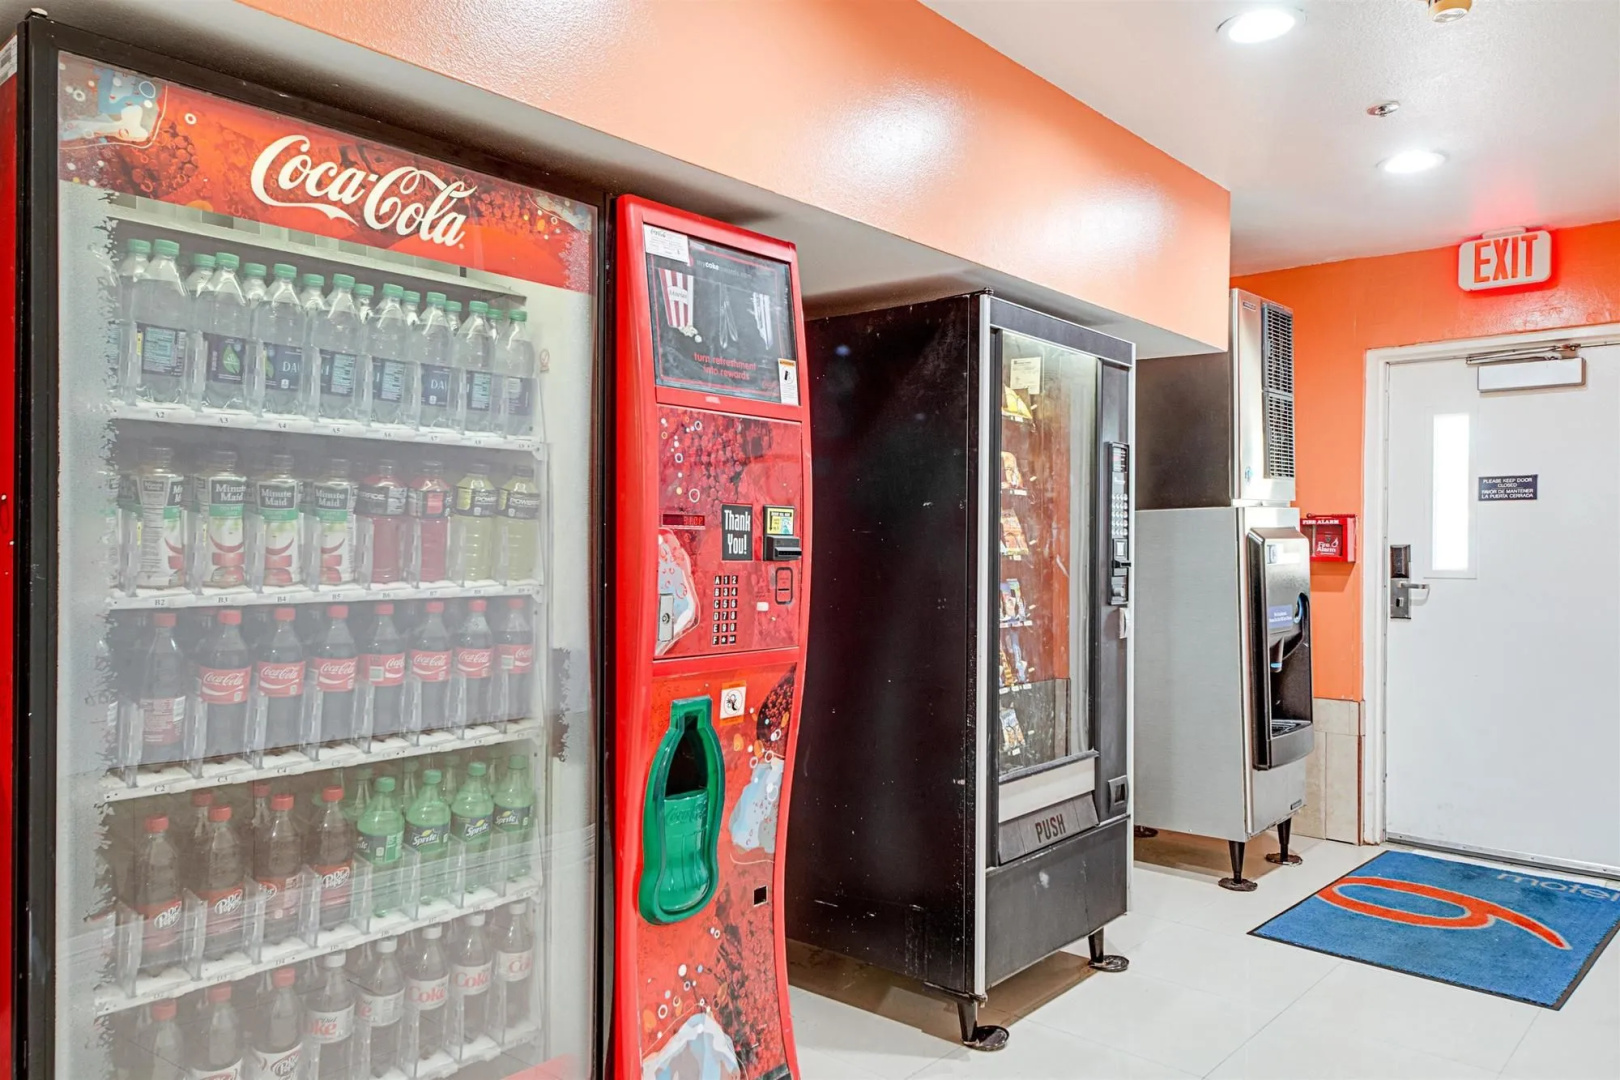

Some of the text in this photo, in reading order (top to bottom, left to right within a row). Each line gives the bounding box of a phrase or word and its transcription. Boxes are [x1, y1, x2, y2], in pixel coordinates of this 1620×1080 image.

[250, 134, 477, 247] Coca-Cola
[1474, 233, 1538, 283] EXIT
[693, 352, 710, 364] turn
[720, 367, 750, 380] rewards
[220, 491, 244, 502] Maid
[261, 487, 292, 498] Minute
[265, 497, 288, 506] Maid
[319, 498, 340, 507] Maid
[724, 509, 751, 532] Thank
[727, 533, 747, 555] You!
[1318, 541, 1330, 549] Fire
[714, 575, 720, 585] A
[732, 575, 737, 584] 2
[714, 588, 720, 597] B
[731, 587, 737, 596] 4
[714, 599, 719, 609] C
[731, 599, 736, 608] 6
[713, 612, 719, 621] D
[730, 611, 736, 620] 8
[713, 624, 718, 633] E
[730, 623, 735, 632] 0
[413, 653, 448, 667] Coca-Cola
[458, 651, 491, 664] Coca-Cola
[260, 665, 300, 680] Coca-Cola
[320, 661, 357, 675] Coca-Cola
[203, 671, 246, 687] Coca-Cola
[495, 814, 518, 826] Sprite
[466, 822, 490, 838] Sprite
[1035, 813, 1067, 844] PUSH
[412, 833, 439, 847] Sprite
[1497, 873, 1620, 902] motel
[454, 971, 491, 987] Coke
[408, 985, 446, 1004] Coke
[312, 1017, 337, 1036] ke
